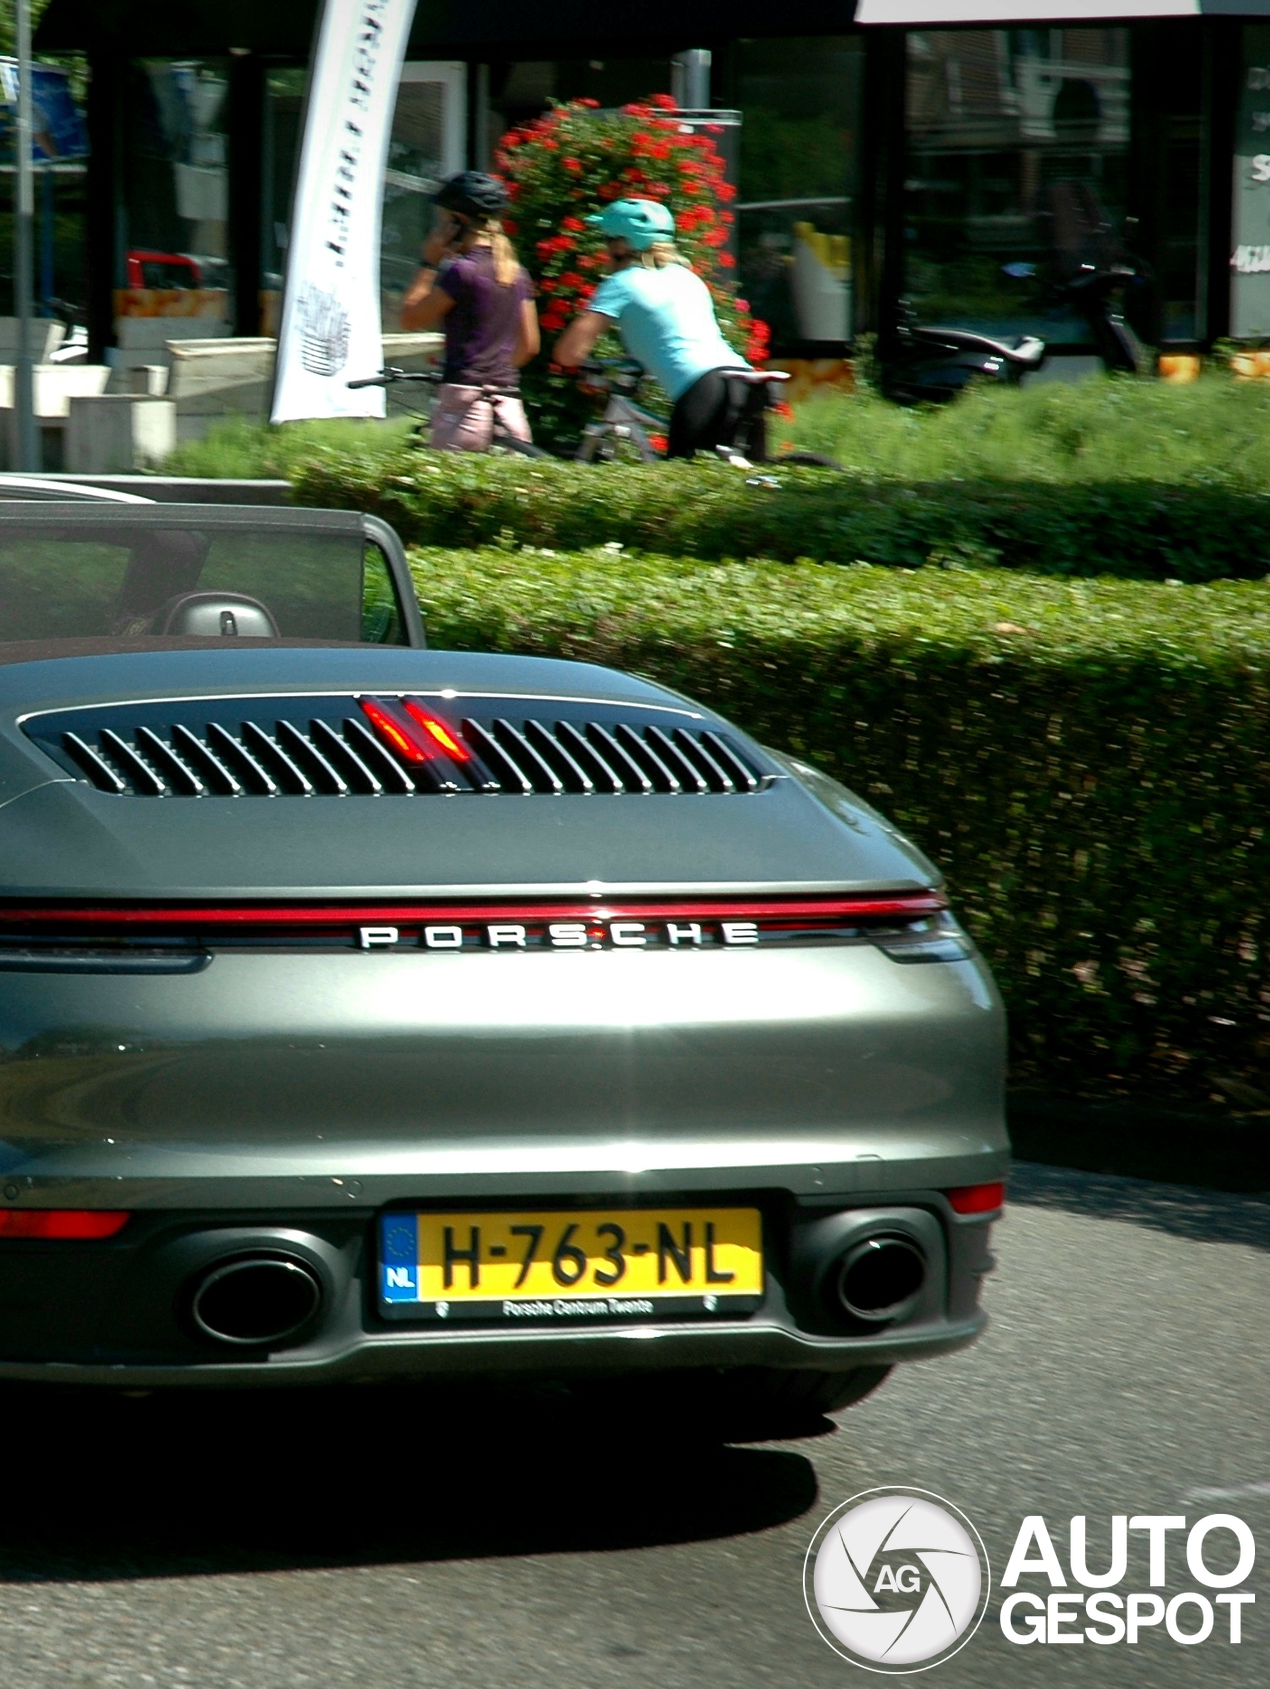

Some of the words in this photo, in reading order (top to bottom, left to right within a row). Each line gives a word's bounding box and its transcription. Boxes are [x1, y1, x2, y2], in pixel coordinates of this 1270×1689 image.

[359, 922, 760, 949] PORSCHE
[442, 1220, 737, 1291] H-763-NL
[386, 1267, 416, 1289] NL
[502, 1299, 554, 1317] Porsche
[553, 1298, 609, 1316] Centrum
[607, 1297, 655, 1314] Twente
